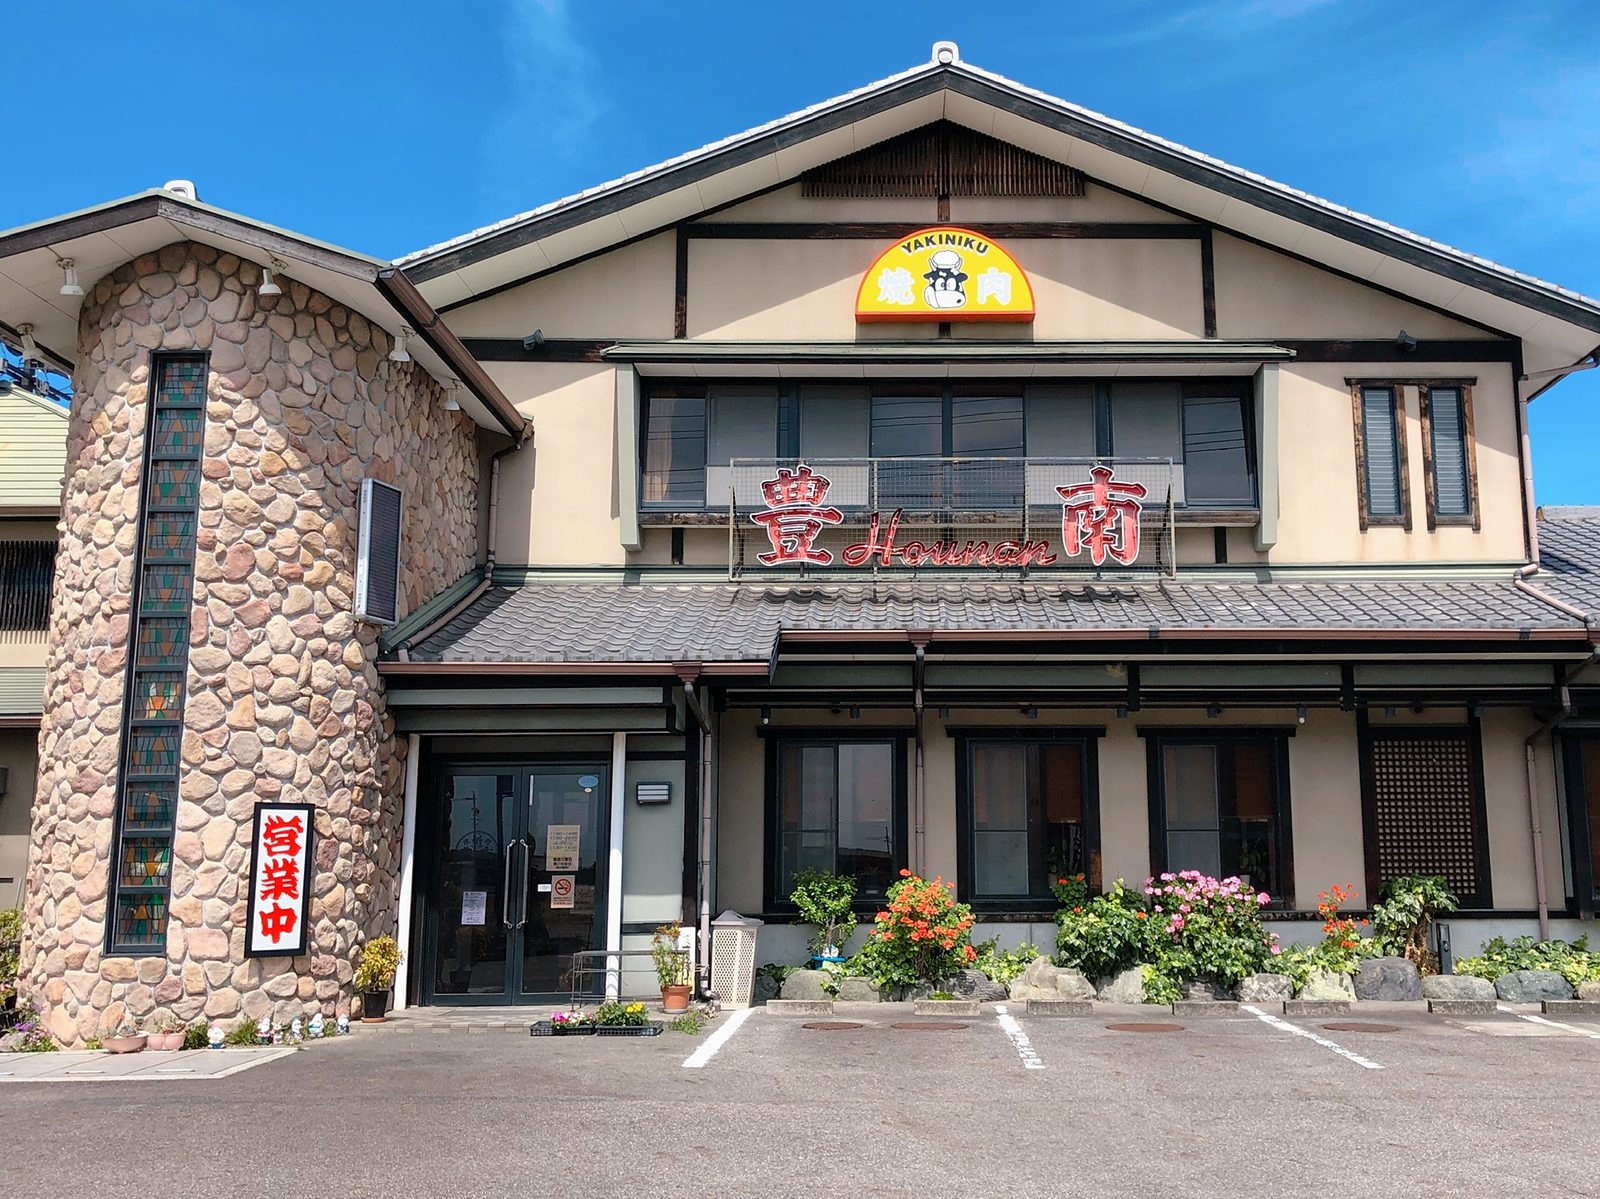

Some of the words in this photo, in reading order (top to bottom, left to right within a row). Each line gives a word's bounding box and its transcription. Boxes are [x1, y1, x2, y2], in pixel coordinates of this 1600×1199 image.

[901, 234, 989, 254] YAKINIKU
[842, 508, 1057, 566] Hounan
[1054, 465, 1149, 566] 南
[259, 815, 303, 943] 営業中
